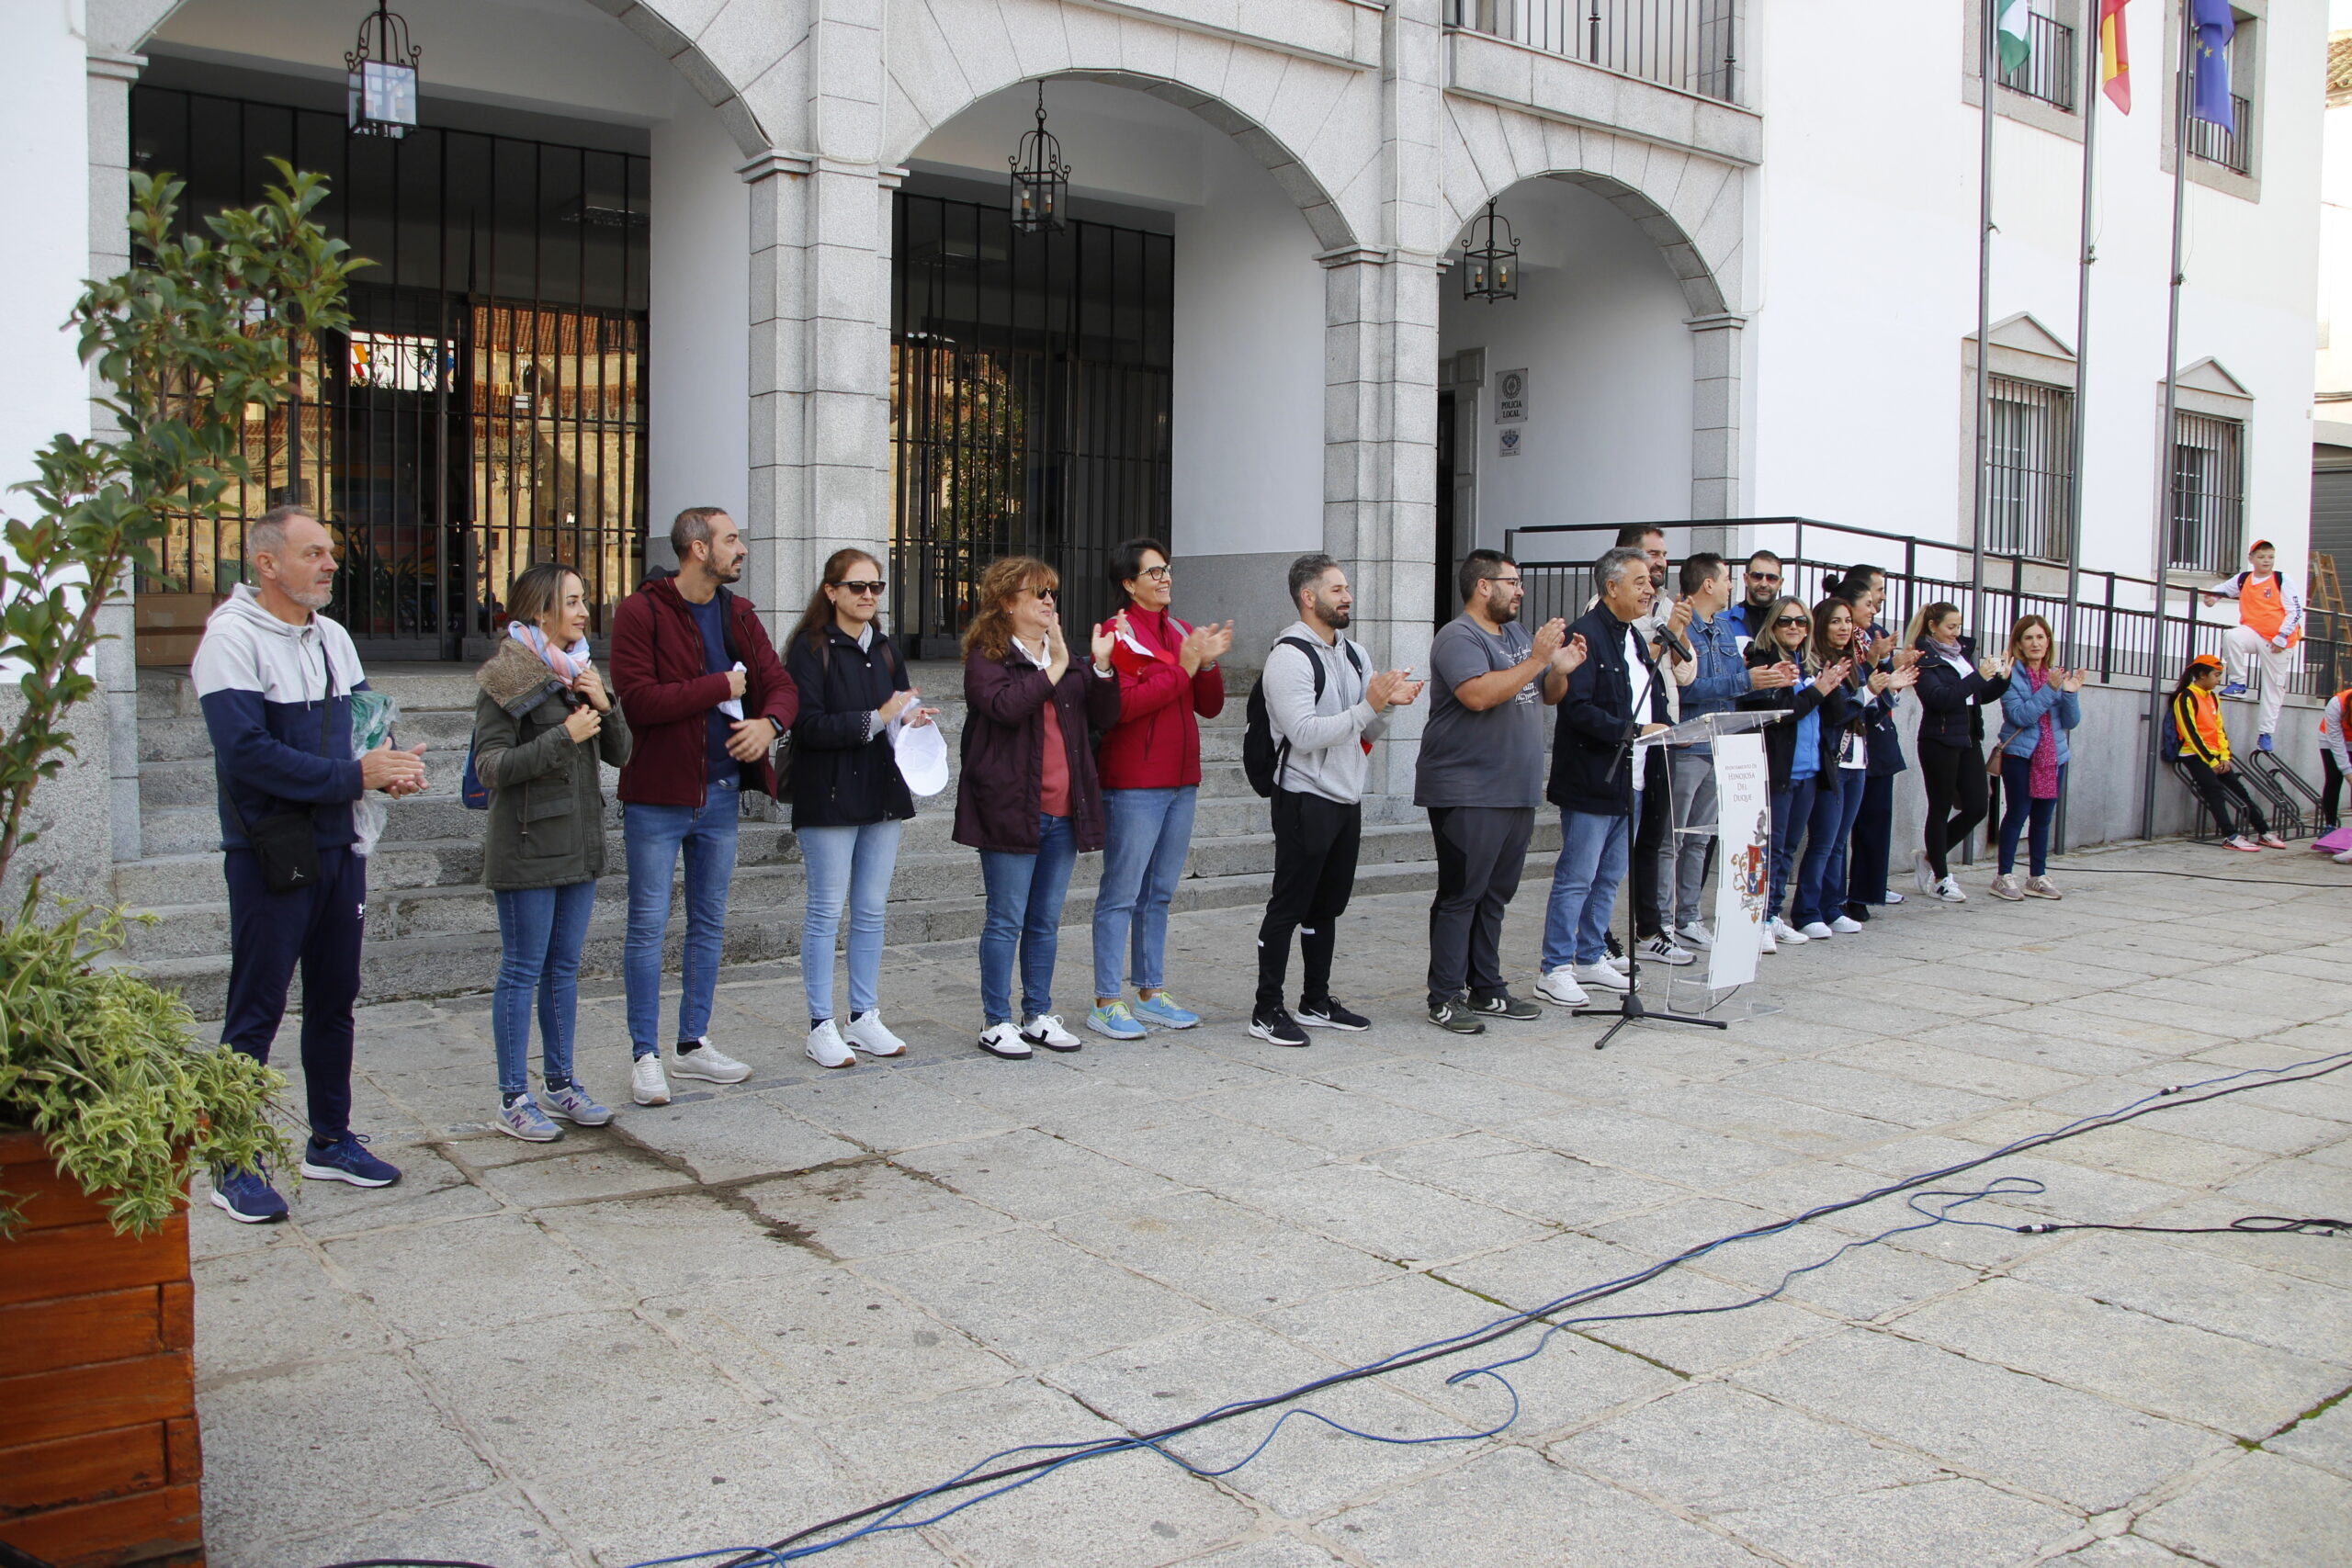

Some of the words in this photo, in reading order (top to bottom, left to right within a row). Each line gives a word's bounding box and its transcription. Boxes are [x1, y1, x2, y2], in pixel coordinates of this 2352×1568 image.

[1503, 410, 1520, 418] LOCAL
[1728, 772, 1756, 780] HINOJOSA
[1737, 783, 1747, 791] DEL
[1734, 794, 1752, 802] DUQUE
[561, 1097, 579, 1111] N
[511, 1114, 526, 1128] N
